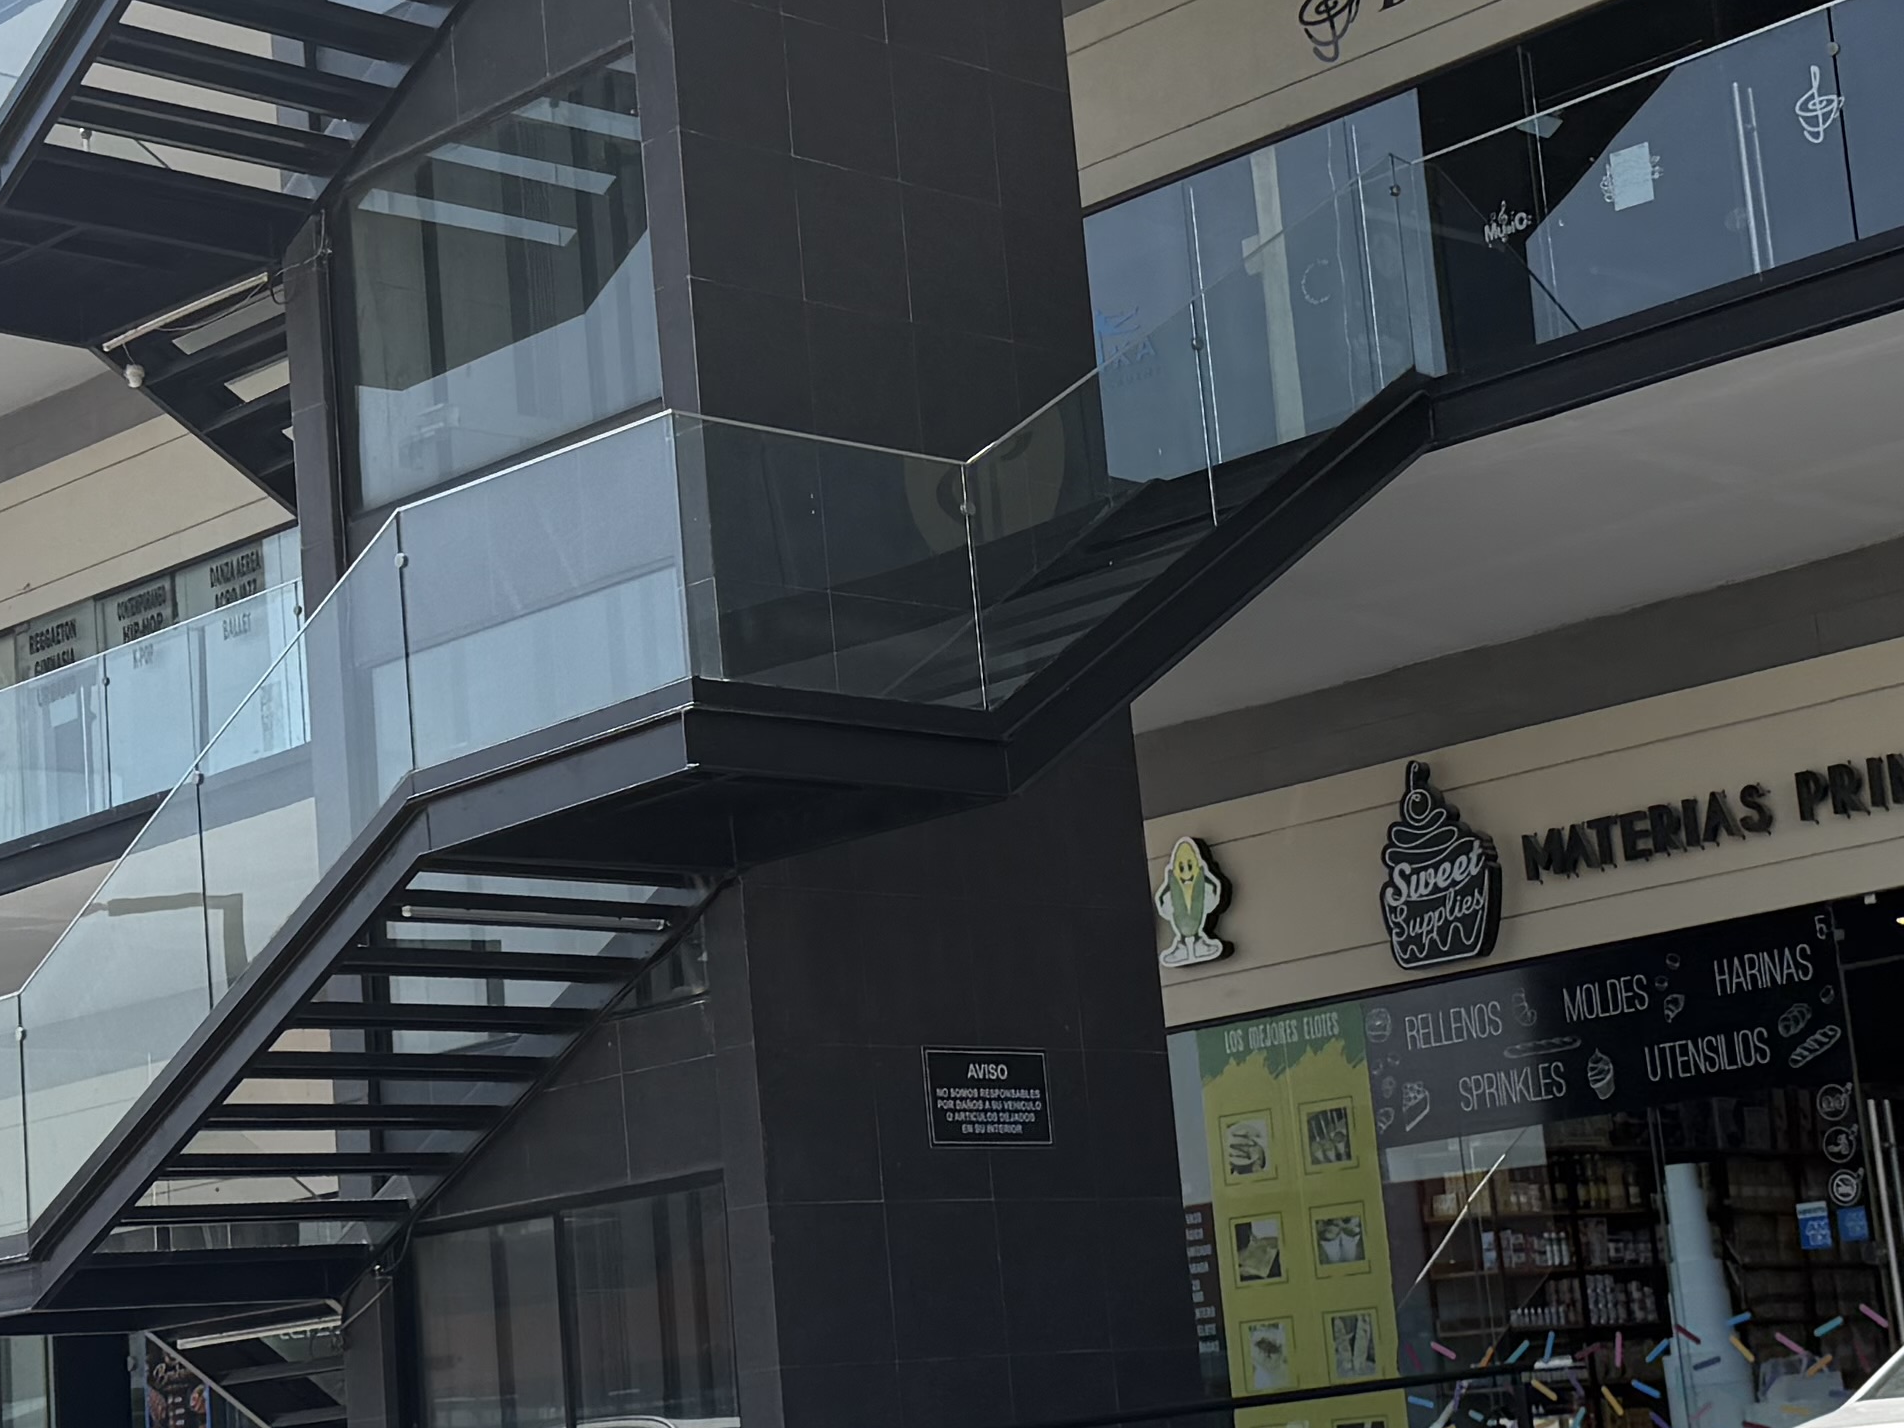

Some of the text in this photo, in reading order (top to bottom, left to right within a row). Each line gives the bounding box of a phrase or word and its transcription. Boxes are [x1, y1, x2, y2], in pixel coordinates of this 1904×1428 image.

[1522, 783, 1775, 884] MATERIAS
[1385, 839, 1484, 906] Sweet
[1392, 888, 1485, 943] Supplies
[1405, 943, 1814, 1051] RELLENOS MOLDES HARINAS
[1224, 1011, 1341, 1054] LOS MEJORES ELOTES
[967, 1063, 1008, 1080] AVISO
[1458, 1027, 1772, 1112] SPRINKLES UTENSILIOS
